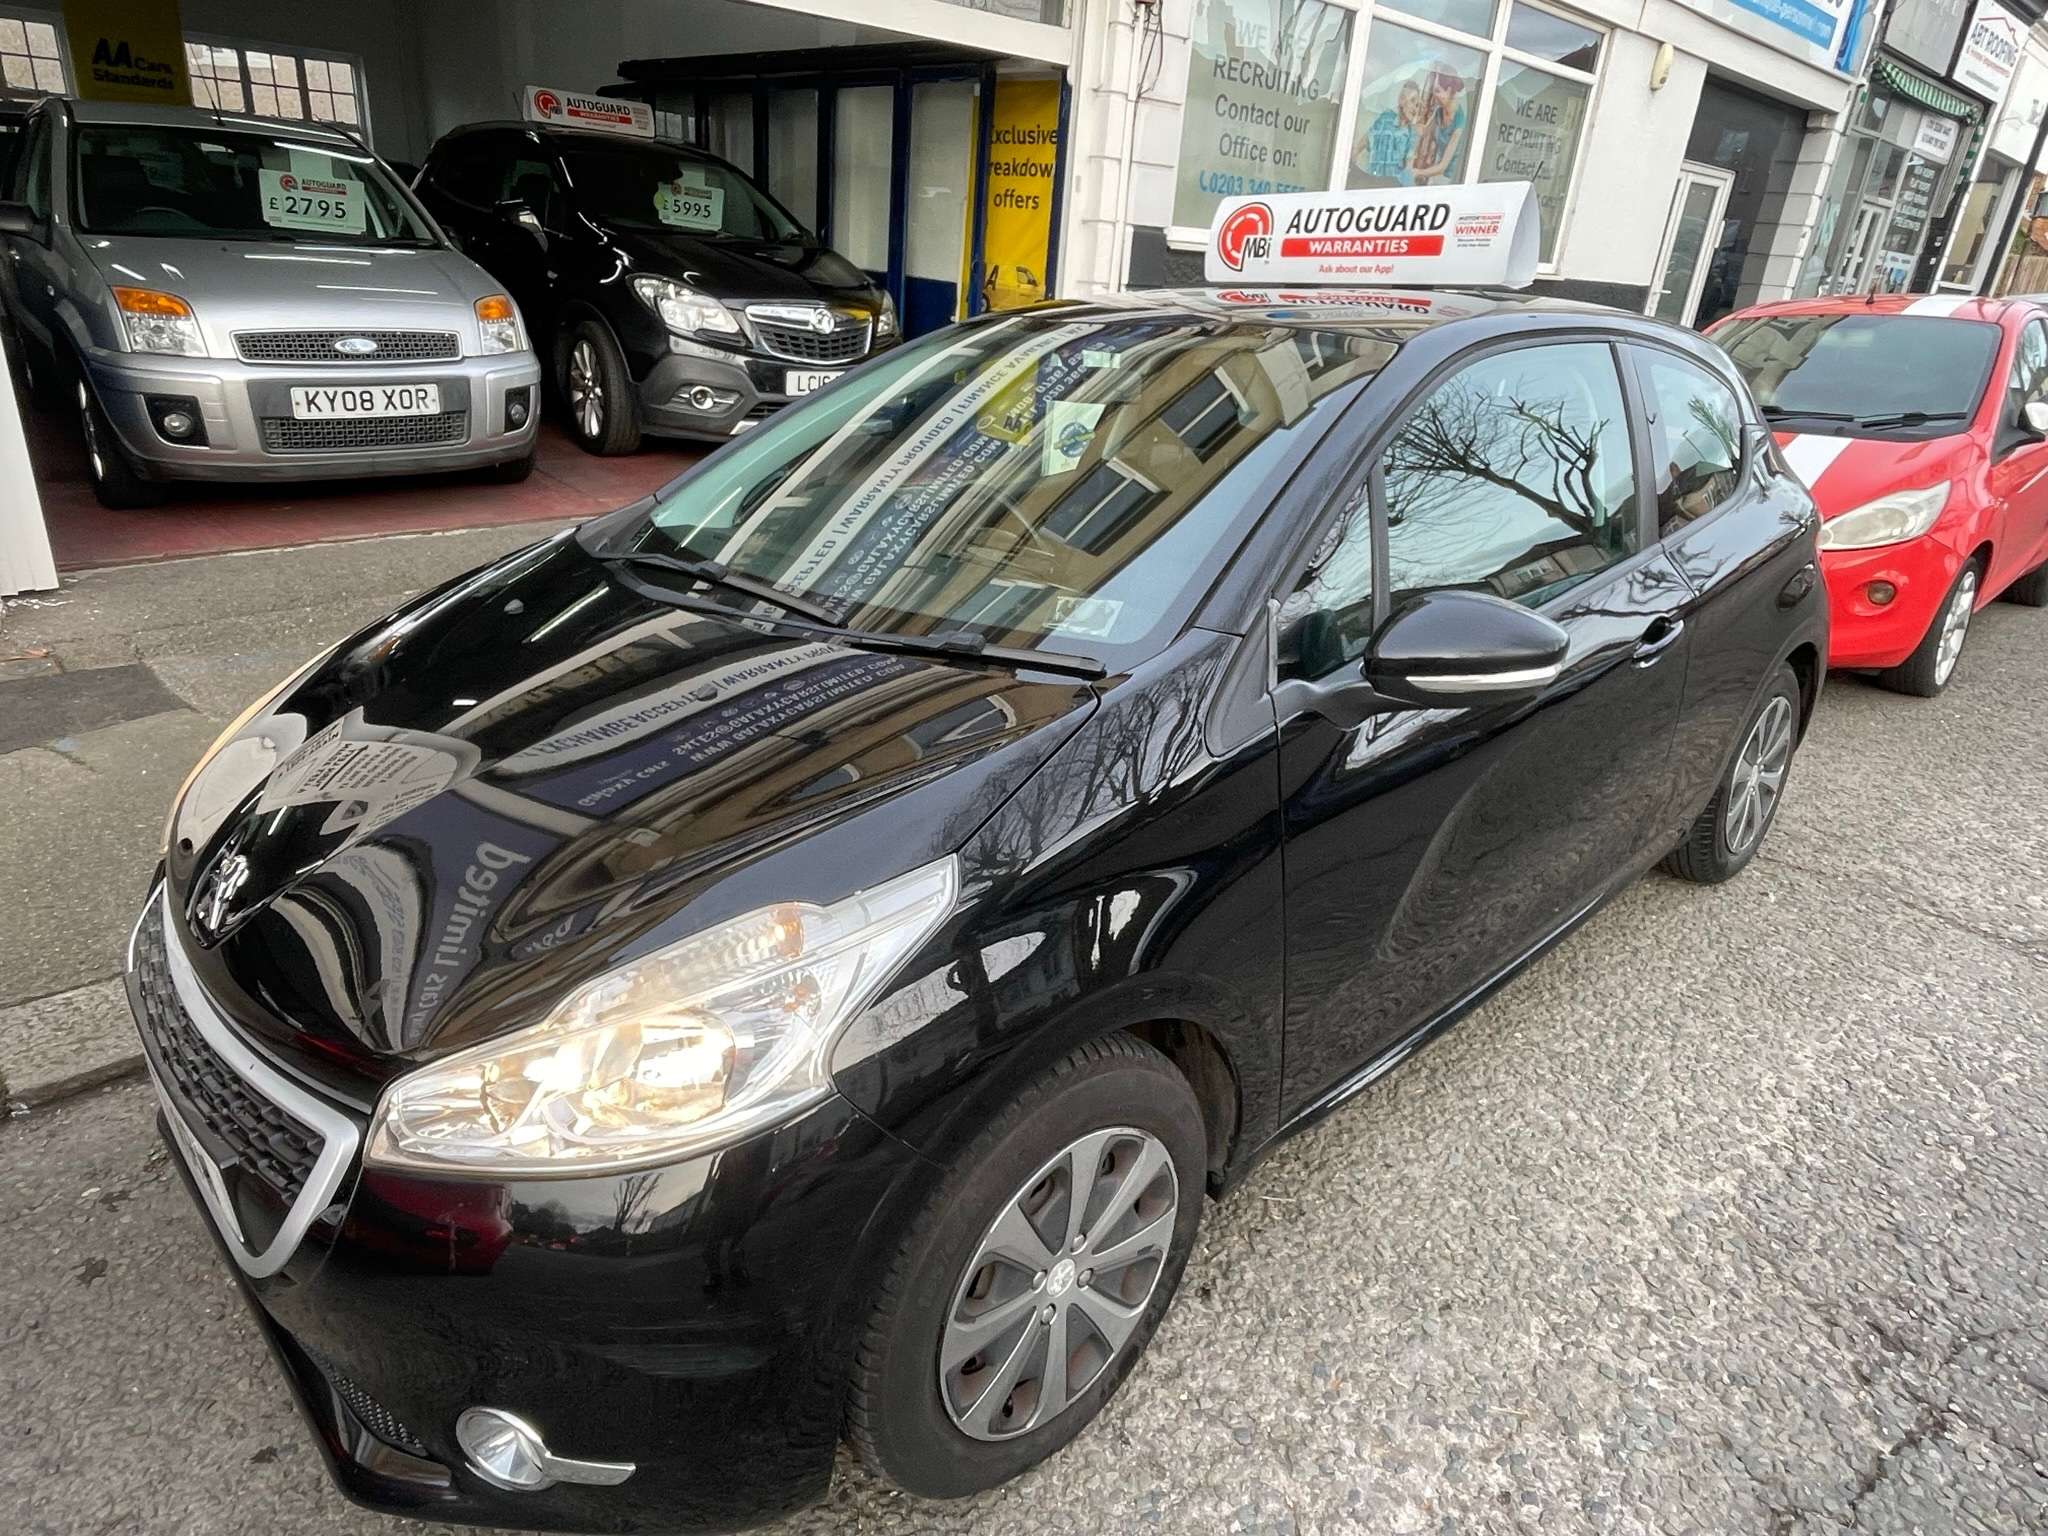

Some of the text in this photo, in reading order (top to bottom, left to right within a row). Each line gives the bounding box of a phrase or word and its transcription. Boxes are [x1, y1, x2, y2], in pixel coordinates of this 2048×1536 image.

[92, 38, 175, 76] AA Cars
[92, 67, 175, 90] Standards
[1212, 55, 1320, 101] RECRUITING
[566, 97, 631, 116] AUTOGUARD
[1215, 93, 1311, 135] Contact our
[1516, 97, 1558, 125] WE ARE
[1218, 133, 1298, 168] Office on:
[987, 156, 1054, 178] reakdow
[1209, 171, 1243, 195] 0203
[993, 188, 1041, 210] offers
[1285, 203, 1451, 235] AUTOGUARD
[1455, 225, 1499, 235] WINNER
[1245, 237, 1272, 259] MBi
[1308, 239, 1409, 254] WARRANTIES
[1318, 263, 1395, 275] Ask about our App!
[303, 388, 430, 413] KY08 XOR
